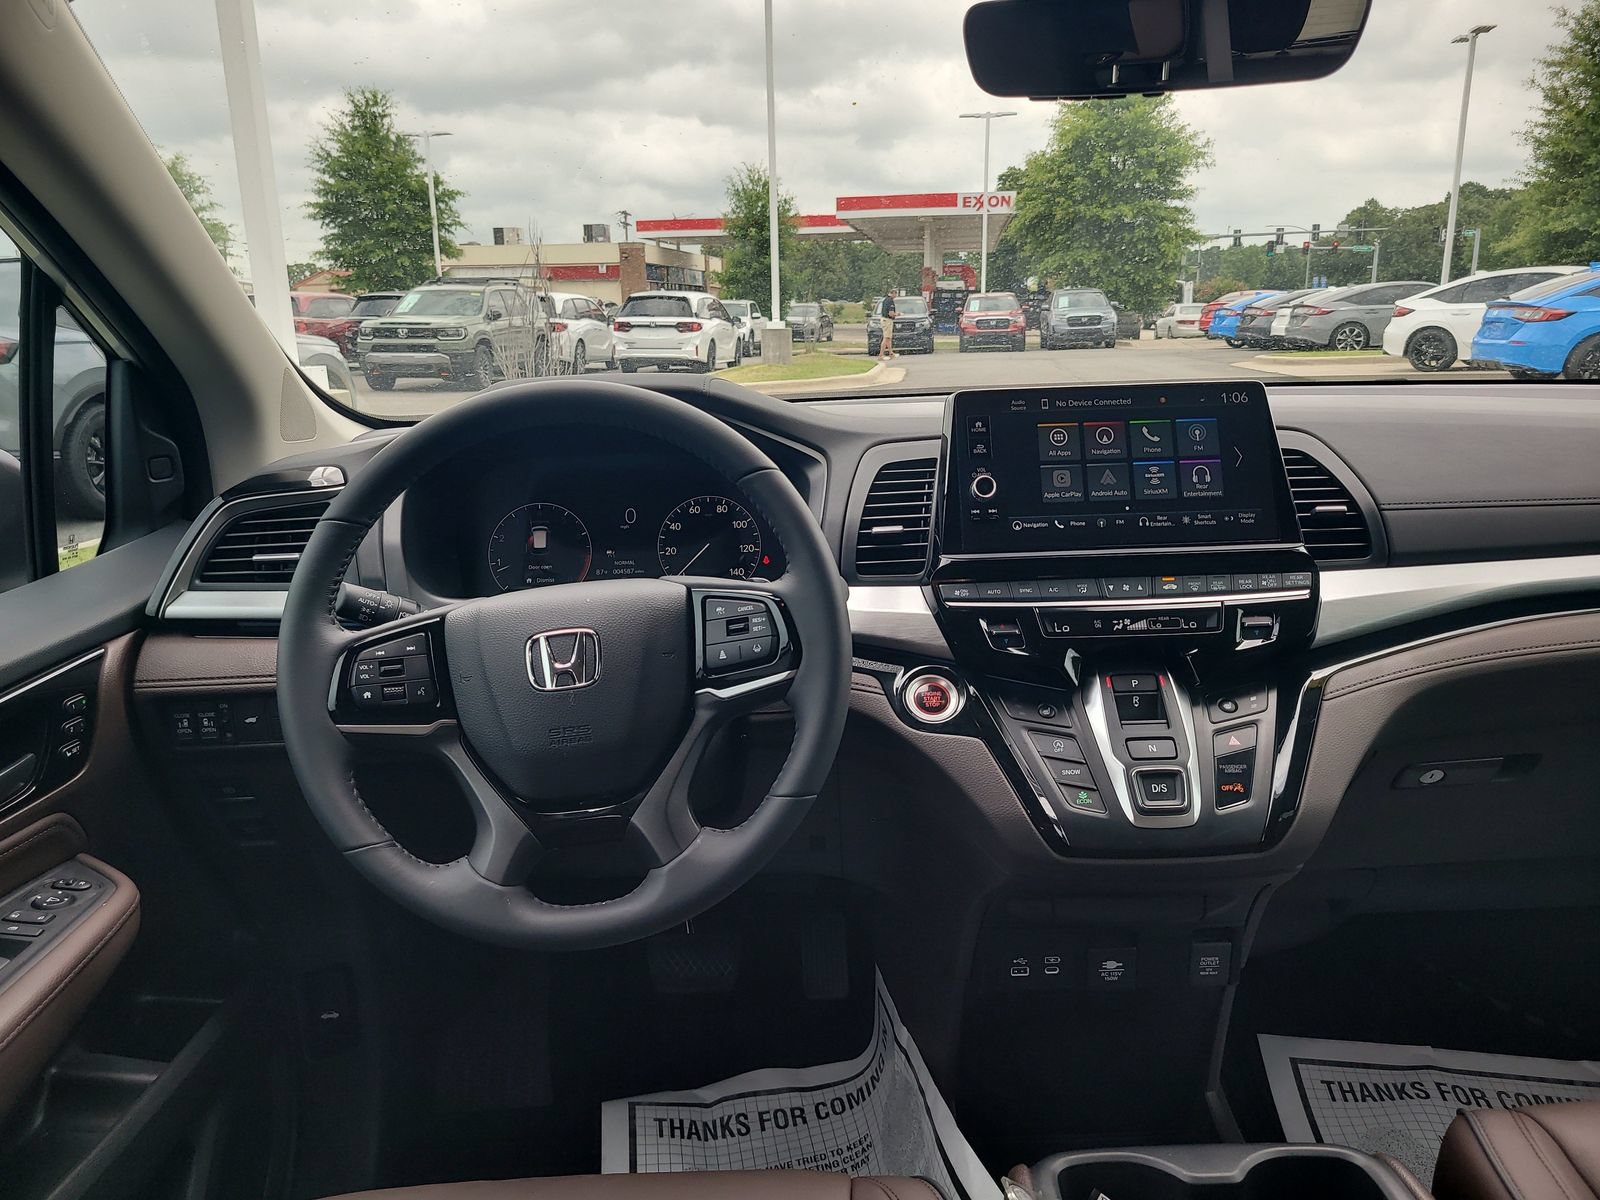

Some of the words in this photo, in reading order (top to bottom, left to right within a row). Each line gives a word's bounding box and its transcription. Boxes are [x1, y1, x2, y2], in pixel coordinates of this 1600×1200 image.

[962, 194, 1012, 212] EXON
[1093, 398, 1132, 406] Connected
[1220, 392, 1249, 404] 1:06
[1091, 448, 1121, 456] Navigation
[1183, 490, 1223, 498] Entertainment
[688, 506, 700, 514] 60
[716, 505, 728, 513] 80
[625, 507, 636, 524] 0
[669, 522, 681, 531] 40
[732, 520, 748, 529] 100
[499, 535, 505, 543] 2
[665, 546, 677, 555] 20
[739, 544, 755, 552] 120
[496, 558, 501, 566] 1
[729, 568, 745, 576] 140
[358, 597, 375, 606] AUTO
[1054, 622, 1070, 632] Lo
[1131, 680, 1138, 688] P
[1133, 696, 1140, 704] R
[1148, 744, 1157, 752] N
[1061, 768, 1081, 776] SNOW
[1151, 783, 1168, 793] D/S
[652, 1112, 751, 1142] THANKS
[759, 1105, 807, 1133] FOR
[814, 1056, 886, 1121] COMING
[1320, 1079, 1431, 1104] THANKS
[1433, 1082, 1494, 1110] FOR
[795, 1153, 827, 1166] TRIED
[829, 1148, 844, 1158] TO
[846, 1133, 870, 1152] KEEP
[843, 1142, 873, 1164] CLEAN
[850, 1154, 871, 1172] MAT
